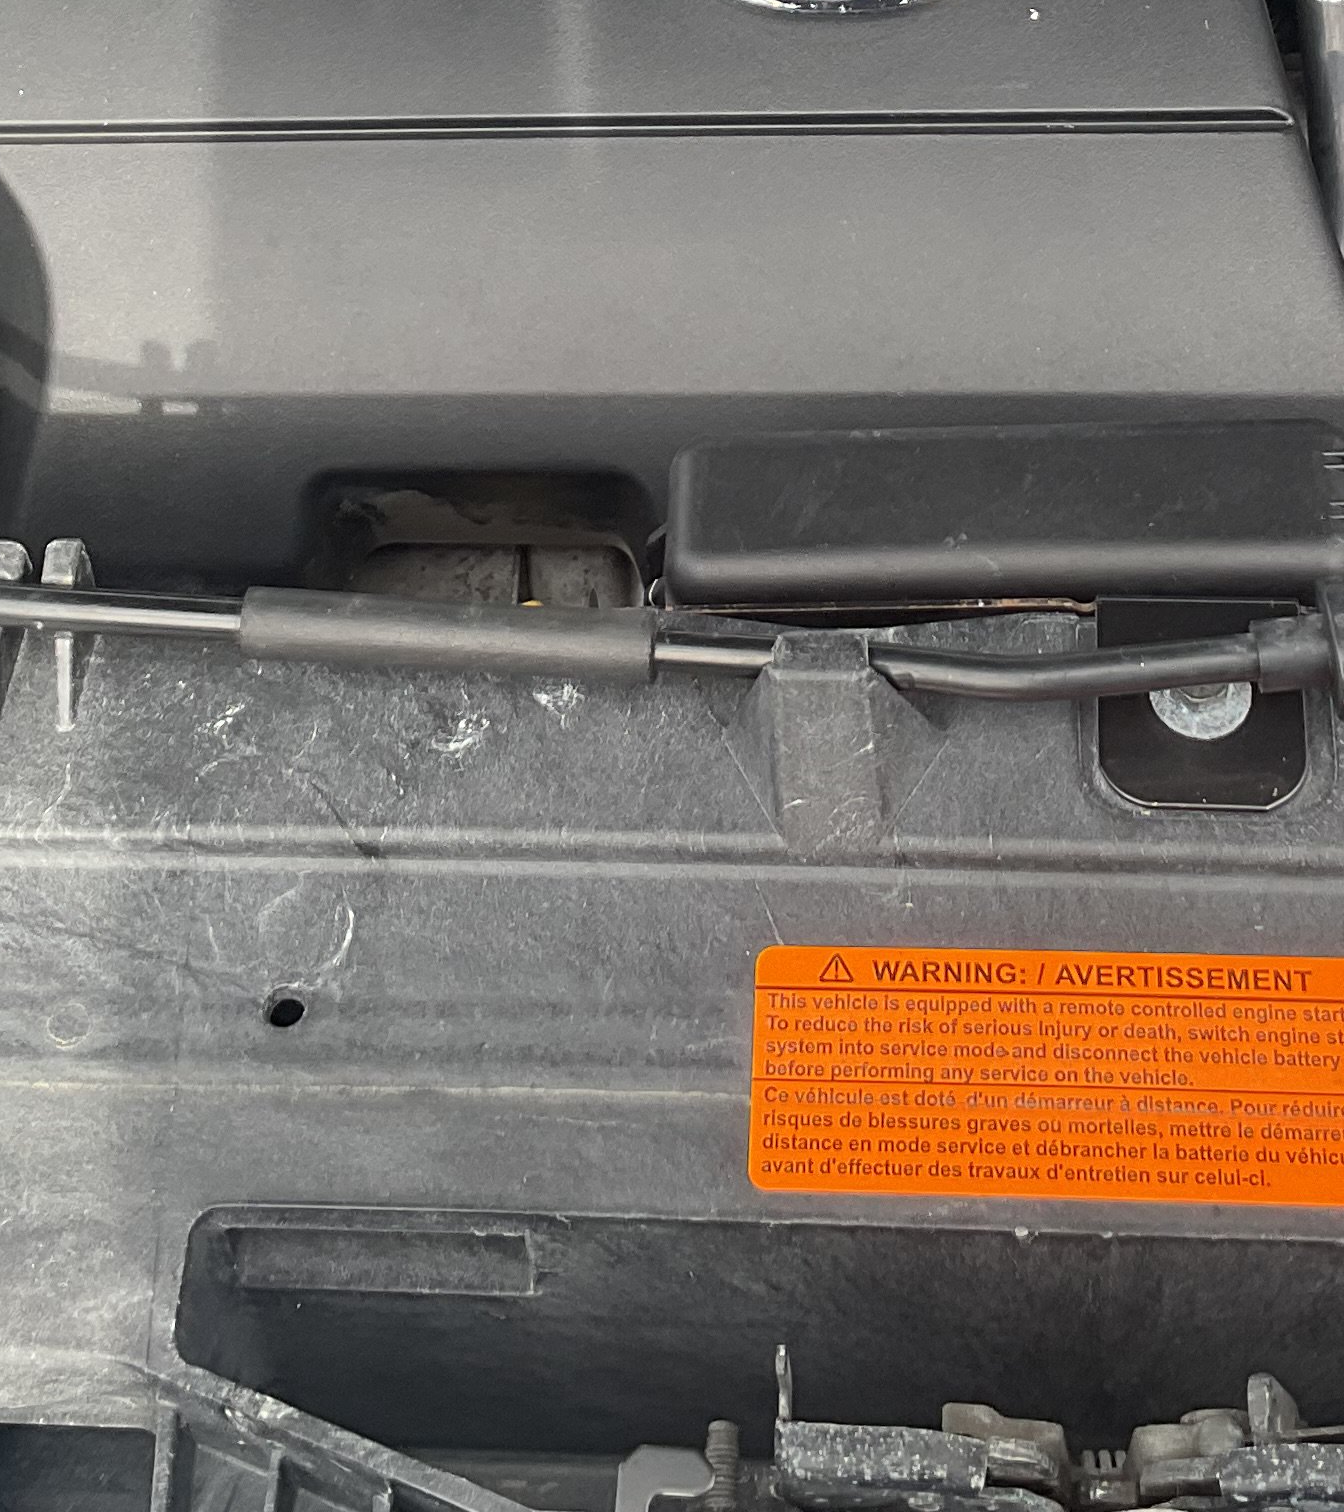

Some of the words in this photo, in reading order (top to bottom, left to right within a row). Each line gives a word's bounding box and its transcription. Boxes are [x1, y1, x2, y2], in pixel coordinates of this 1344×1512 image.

[871, 958, 1026, 986] WARNING:
[1037, 961, 1046, 986] /
[1054, 963, 1313, 993] AVERTISSEMENT
[767, 991, 807, 1011] This
[812, 992, 879, 1011] vehicle
[884, 994, 900, 1012] is
[905, 994, 992, 1017] equipped
[997, 996, 1037, 1015] with
[1043, 1000, 1054, 1015] a
[1059, 999, 1125, 1017] remote
[1130, 1000, 1227, 1019] controlled
[1232, 1003, 1297, 1025] engine
[765, 1013, 789, 1033] To
[794, 1014, 858, 1034] reduce
[863, 1015, 893, 1034] the
[898, 1016, 934, 1035] risk
[938, 1017, 958, 1036] of
[963, 1018, 1033, 1037] serious
[1039, 1019, 1092, 1042] injury
[1097, 1025, 1119, 1039] or
[1123, 1022, 1182, 1044] death,
[1187, 1024, 1250, 1043] switch
[1255, 1026, 1321, 1048] engine
[766, 1037, 833, 1059] system
[839, 1037, 875, 1057] into
[879, 1039, 948, 1058] service
[953, 1041, 1009, 1060] mode
[1011, 1042, 1047, 1060] and
[1052, 1042, 1159, 1063] disconnect
[1163, 1046, 1194, 1064] the
[1198, 1046, 1268, 1066] vehicle
[1273, 1049, 1341, 1073] battery
[765, 1058, 825, 1078] before
[830, 1060, 934, 1082] performing
[940, 1066, 974, 1083] any
[980, 1064, 1049, 1083] service
[1054, 1069, 1078, 1084] on
[1083, 1065, 1114, 1085] the
[1119, 1067, 1194, 1087] vehicle.
[764, 1085, 789, 1104] Ce
[794, 1086, 874, 1106] véhicule
[879, 1089, 909, 1107] est
[914, 1089, 956, 1109] doté
[966, 1090, 1008, 1110] d'un
[1014, 1091, 1115, 1113] démarreur
[1119, 1093, 1131, 1113] à
[1136, 1095, 1224, 1116] distance.
[1230, 1097, 1277, 1117] Pour
[763, 1108, 834, 1132] risques
[839, 1110, 863, 1129] de
[868, 1110, 962, 1132] blessures
[966, 1117, 1032, 1136] graves
[1037, 1118, 1062, 1135] ou
[1068, 1117, 1164, 1140] mortelles,
[1169, 1121, 1232, 1139] mettre
[1237, 1121, 1254, 1140] le
[762, 1131, 843, 1152] distance
[848, 1138, 872, 1153] en
[877, 1136, 931, 1155] mode
[936, 1136, 1006, 1156] service
[1011, 1139, 1030, 1157] et
[1035, 1138, 1148, 1160] débrancher
[1153, 1141, 1170, 1162] la
[1175, 1142, 1250, 1164] batterie
[1255, 1145, 1281, 1165] du
[761, 1157, 814, 1175] avant
[819, 1156, 923, 1178] d'effectuer
[927, 1159, 963, 1179] des
[967, 1160, 1041, 1181] travaux
[1046, 1162, 1151, 1185] d'entretien
[1156, 1169, 1189, 1185] sur
[1194, 1167, 1271, 1188] celui-ci.
